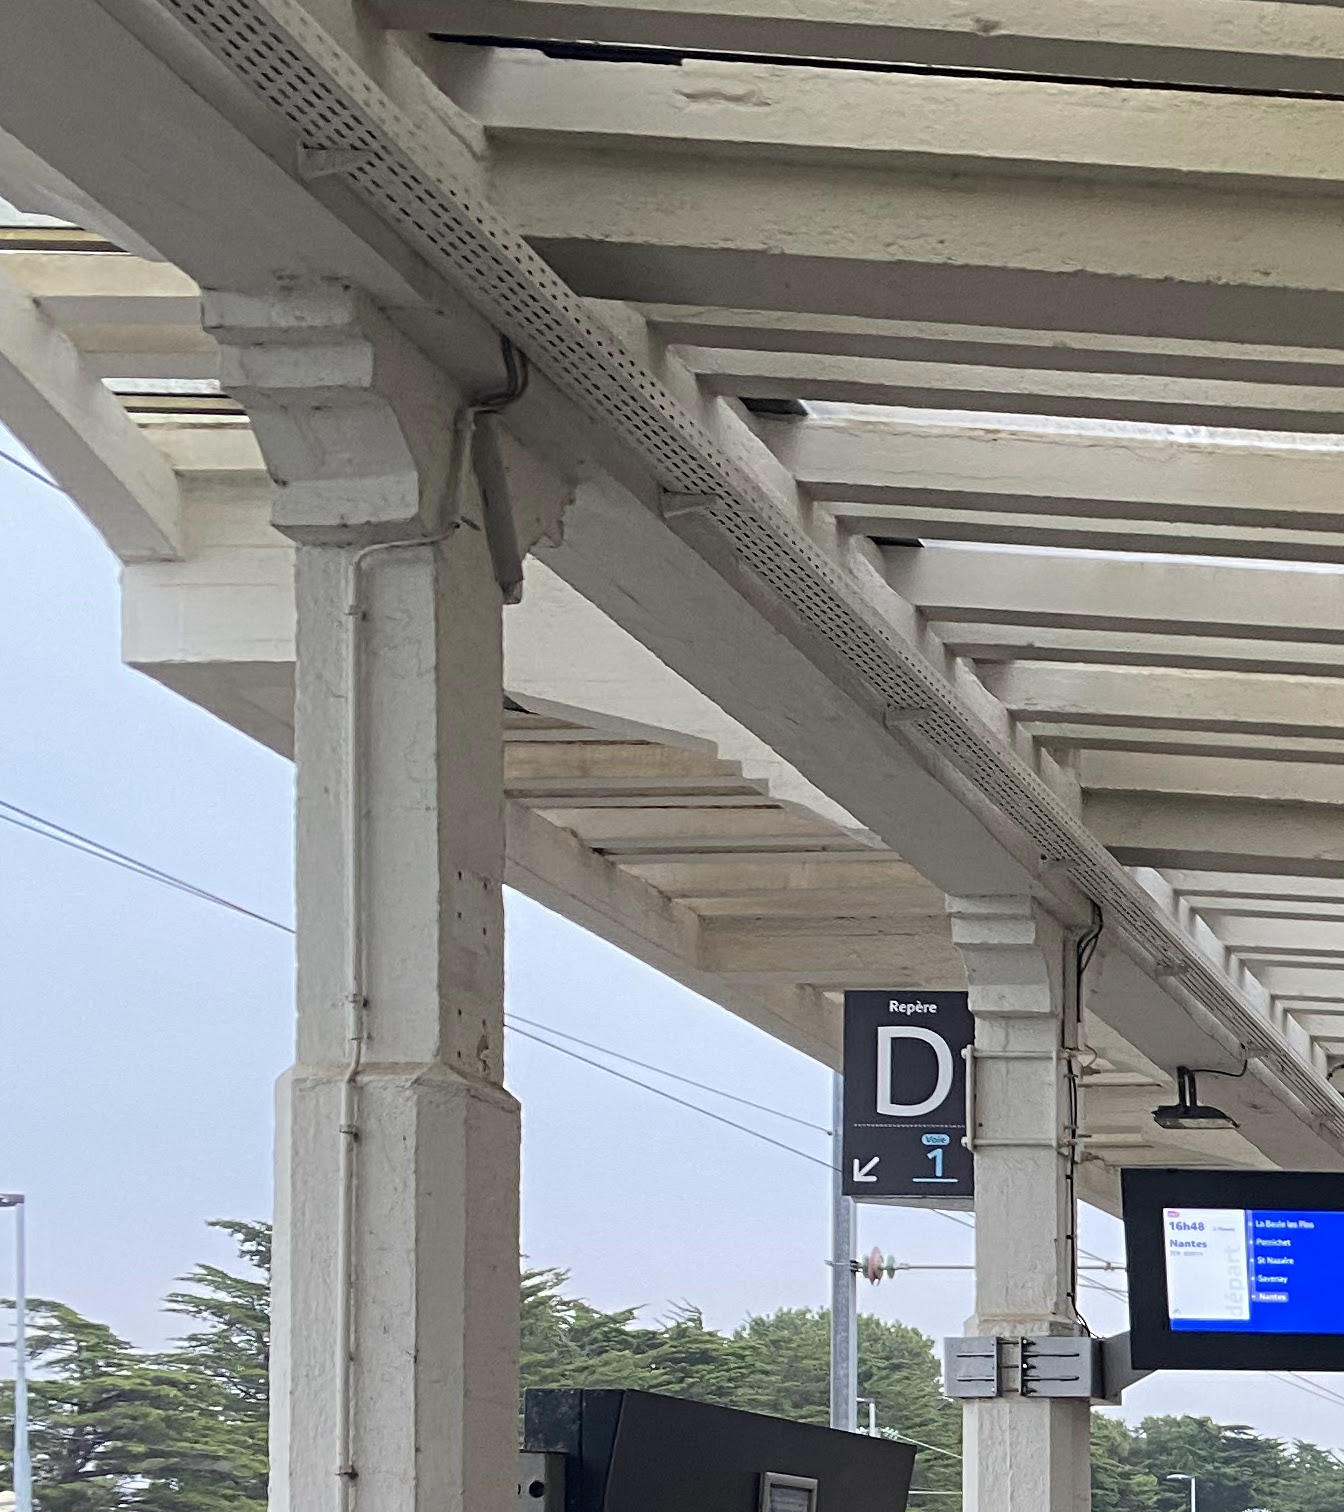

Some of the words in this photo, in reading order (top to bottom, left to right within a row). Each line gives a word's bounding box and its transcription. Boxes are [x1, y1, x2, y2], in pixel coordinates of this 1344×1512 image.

[889, 1000, 938, 1015] Repère
[876, 1026, 954, 1117] D
[925, 1135, 946, 1143] Voie
[926, 1148, 943, 1177] 1
[1168, 1221, 1205, 1232] 16h48
[1169, 1239, 1207, 1249] Nantes
[1257, 1256, 1266, 1264] St
